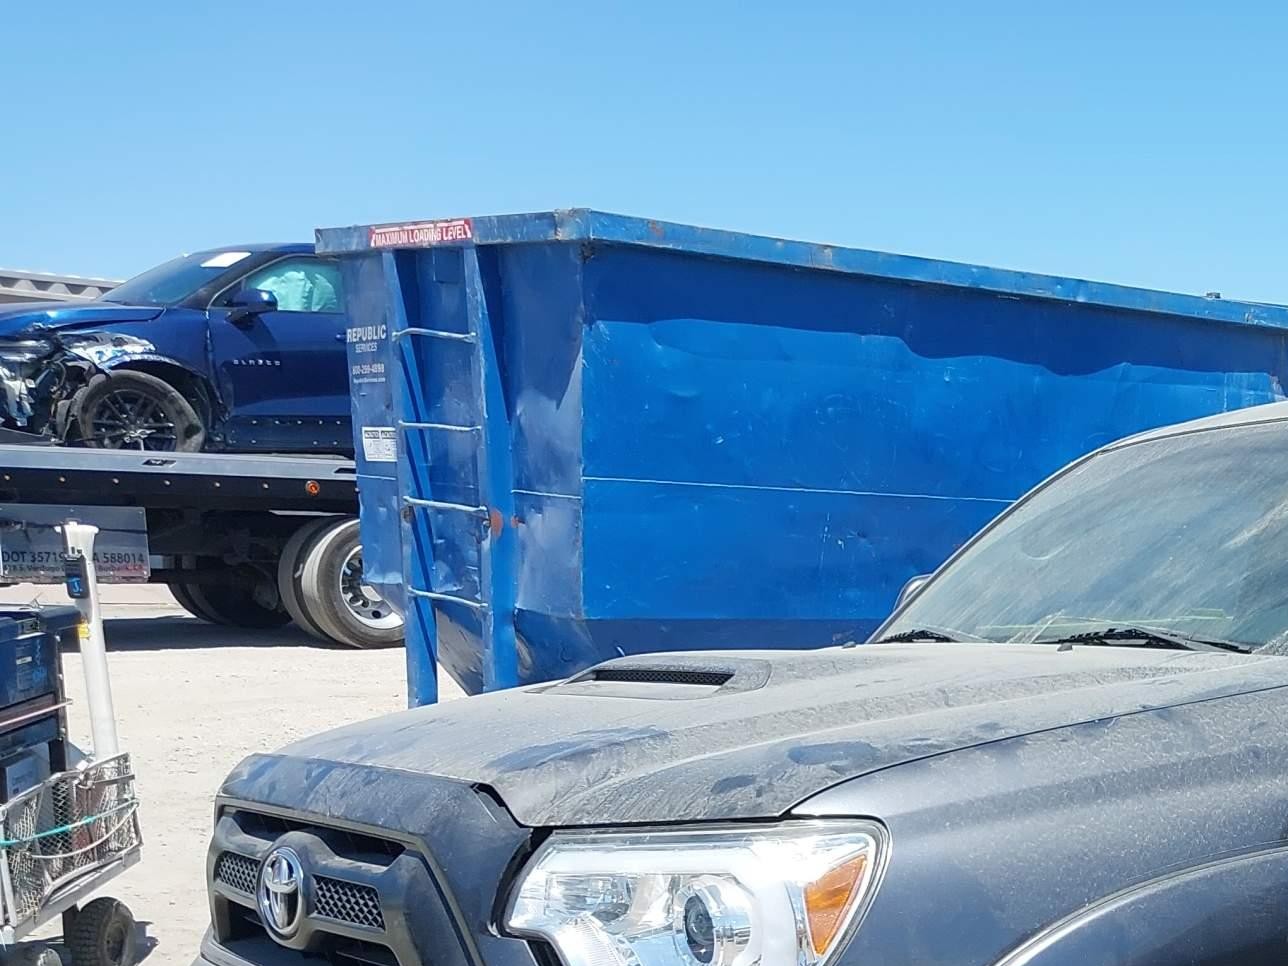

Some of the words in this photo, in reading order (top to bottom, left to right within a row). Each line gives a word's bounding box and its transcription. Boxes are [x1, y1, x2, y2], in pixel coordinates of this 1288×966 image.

[375, 230, 408, 247] MAXIMUM
[408, 227, 442, 244] LOADING
[442, 225, 465, 241] LEVEL
[346, 325, 386, 342] REPUBLIC
[1, 551, 27, 563] DOT
[103, 552, 145, 564] 588014
